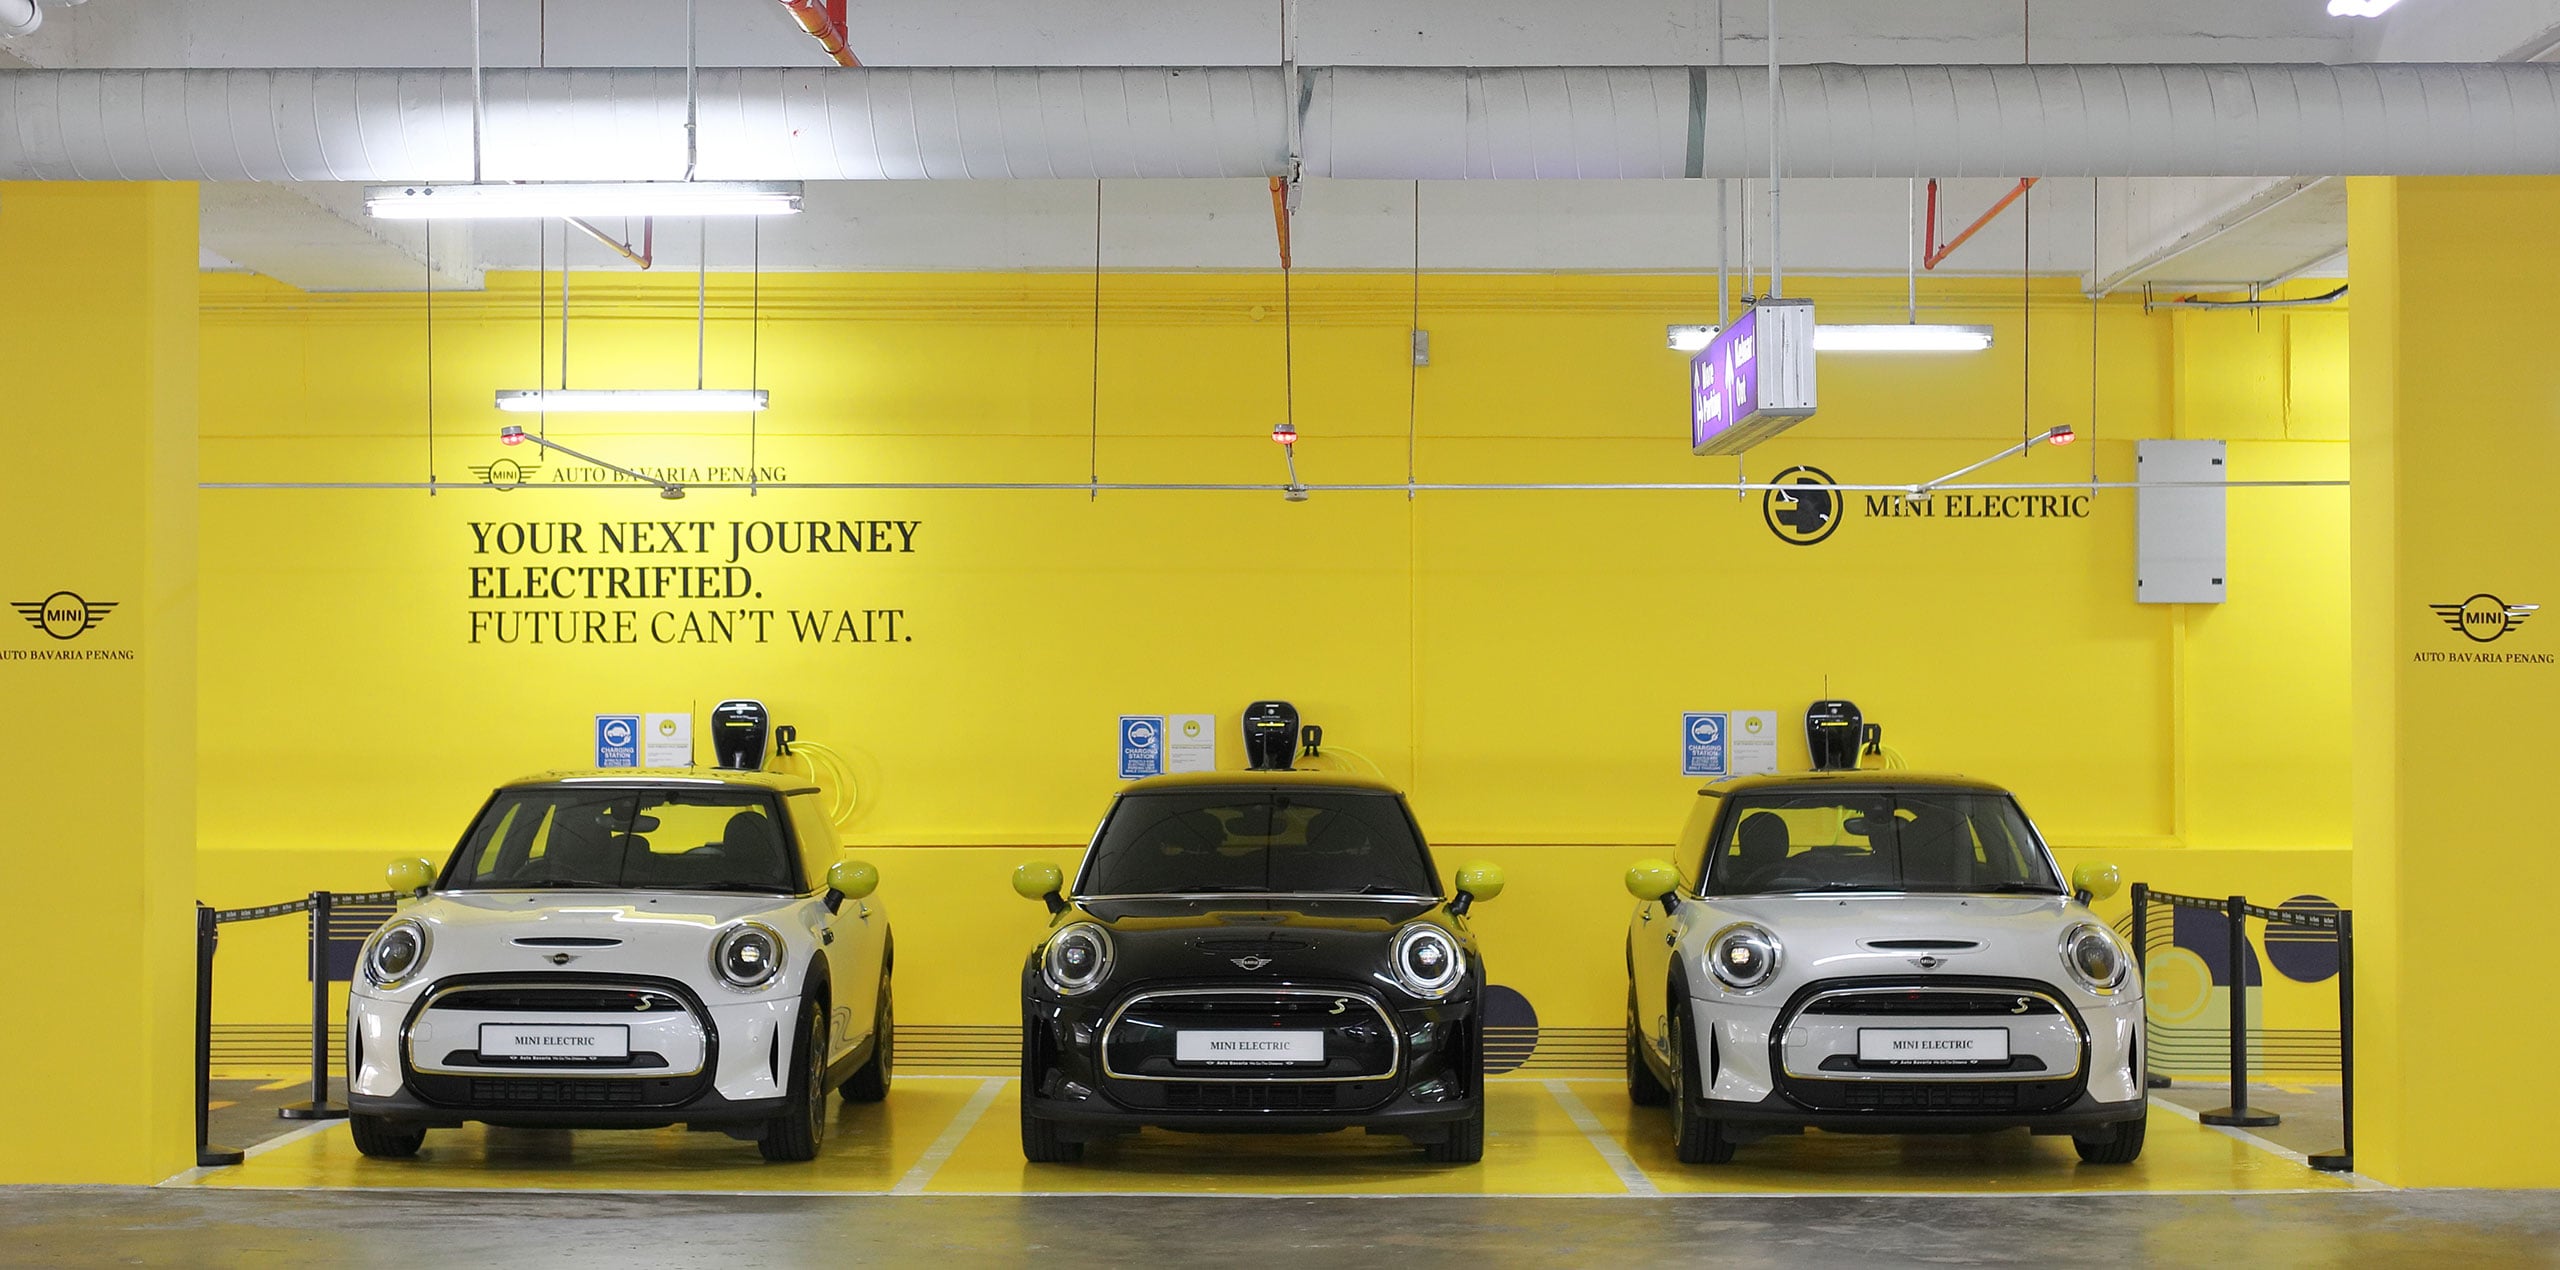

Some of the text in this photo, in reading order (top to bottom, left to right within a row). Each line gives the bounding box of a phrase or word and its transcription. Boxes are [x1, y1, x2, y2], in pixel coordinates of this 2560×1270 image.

[492, 471, 517, 480] MINI
[552, 467, 606, 483] AUTO
[708, 466, 787, 482] PENANG
[1865, 495, 2090, 518] MINI ELECTRIC
[467, 521, 922, 563] YOUR NEXT JOURNEY
[468, 567, 763, 599] ELECTRIFIED.
[47, 609, 82, 621] MINI
[2466, 612, 2502, 624] MINI
[468, 611, 637, 644] FUTURE
[788, 609, 912, 643] WAIT.
[30, 650, 83, 660] BAVARIA
[86, 650, 134, 660] PENANG
[2413, 652, 2554, 664] AUTO BAVARIA PENANG
[634, 994, 654, 1011] S
[1328, 998, 1348, 1014] S
[2011, 997, 2030, 1014] S
[515, 1036, 595, 1045] MINI ELECTRIC
[1210, 1041, 1290, 1050] MINI ELECTRIC
[1893, 1040, 1974, 1049] MINI ELECTRIC
